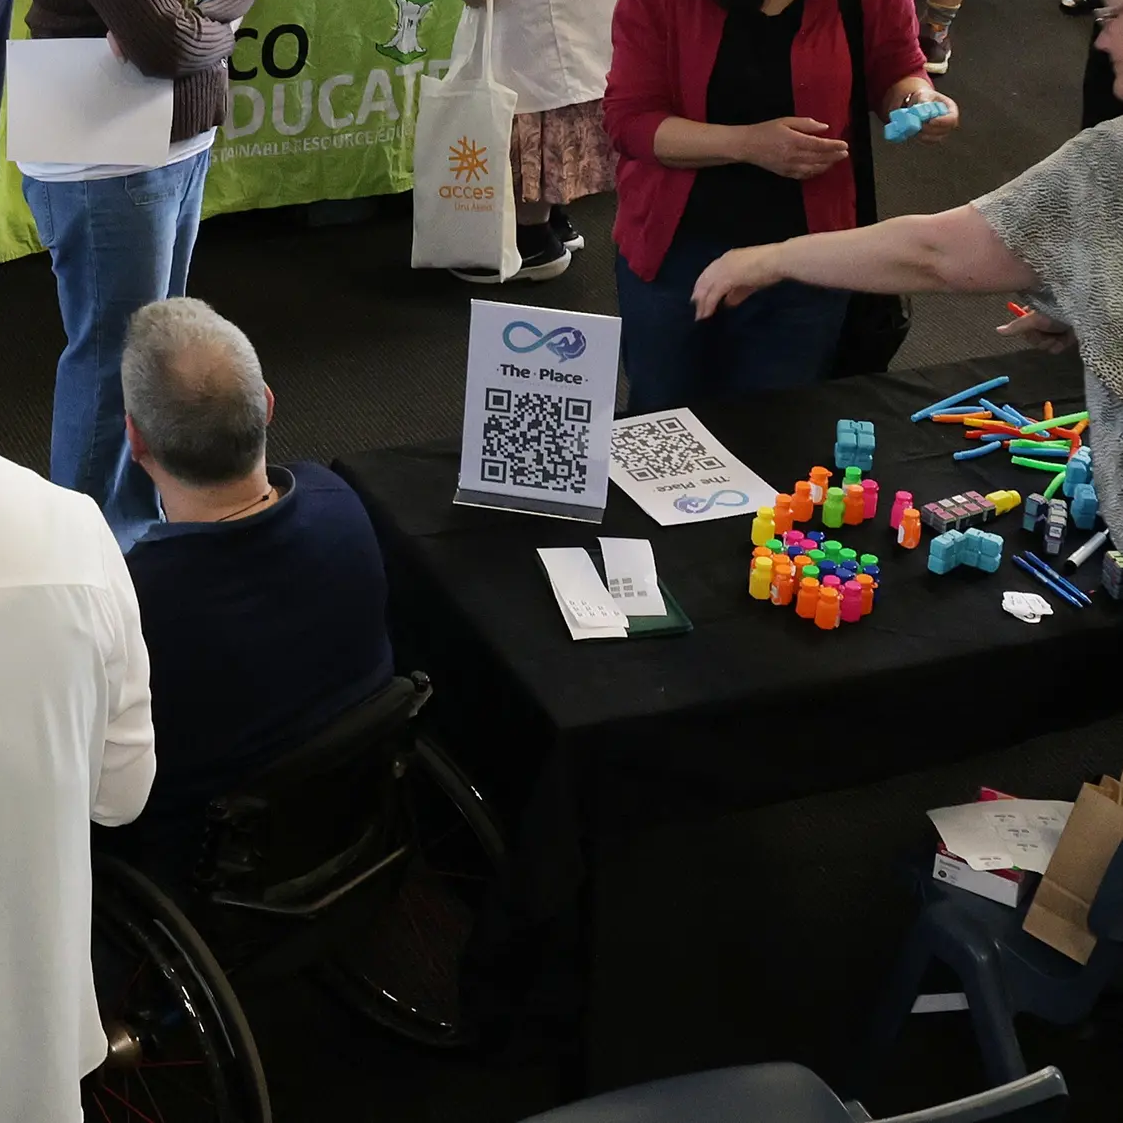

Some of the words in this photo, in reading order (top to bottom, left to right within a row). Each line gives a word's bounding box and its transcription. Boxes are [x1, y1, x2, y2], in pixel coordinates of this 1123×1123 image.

[228, 23, 309, 81] CO
[224, 59, 452, 141] DUCAT
[211, 140, 290, 164] STAINABLE
[500, 364, 530, 379] The
[539, 368, 583, 385] Place
[657, 481, 696, 492] Place
[700, 475, 728, 485] The
